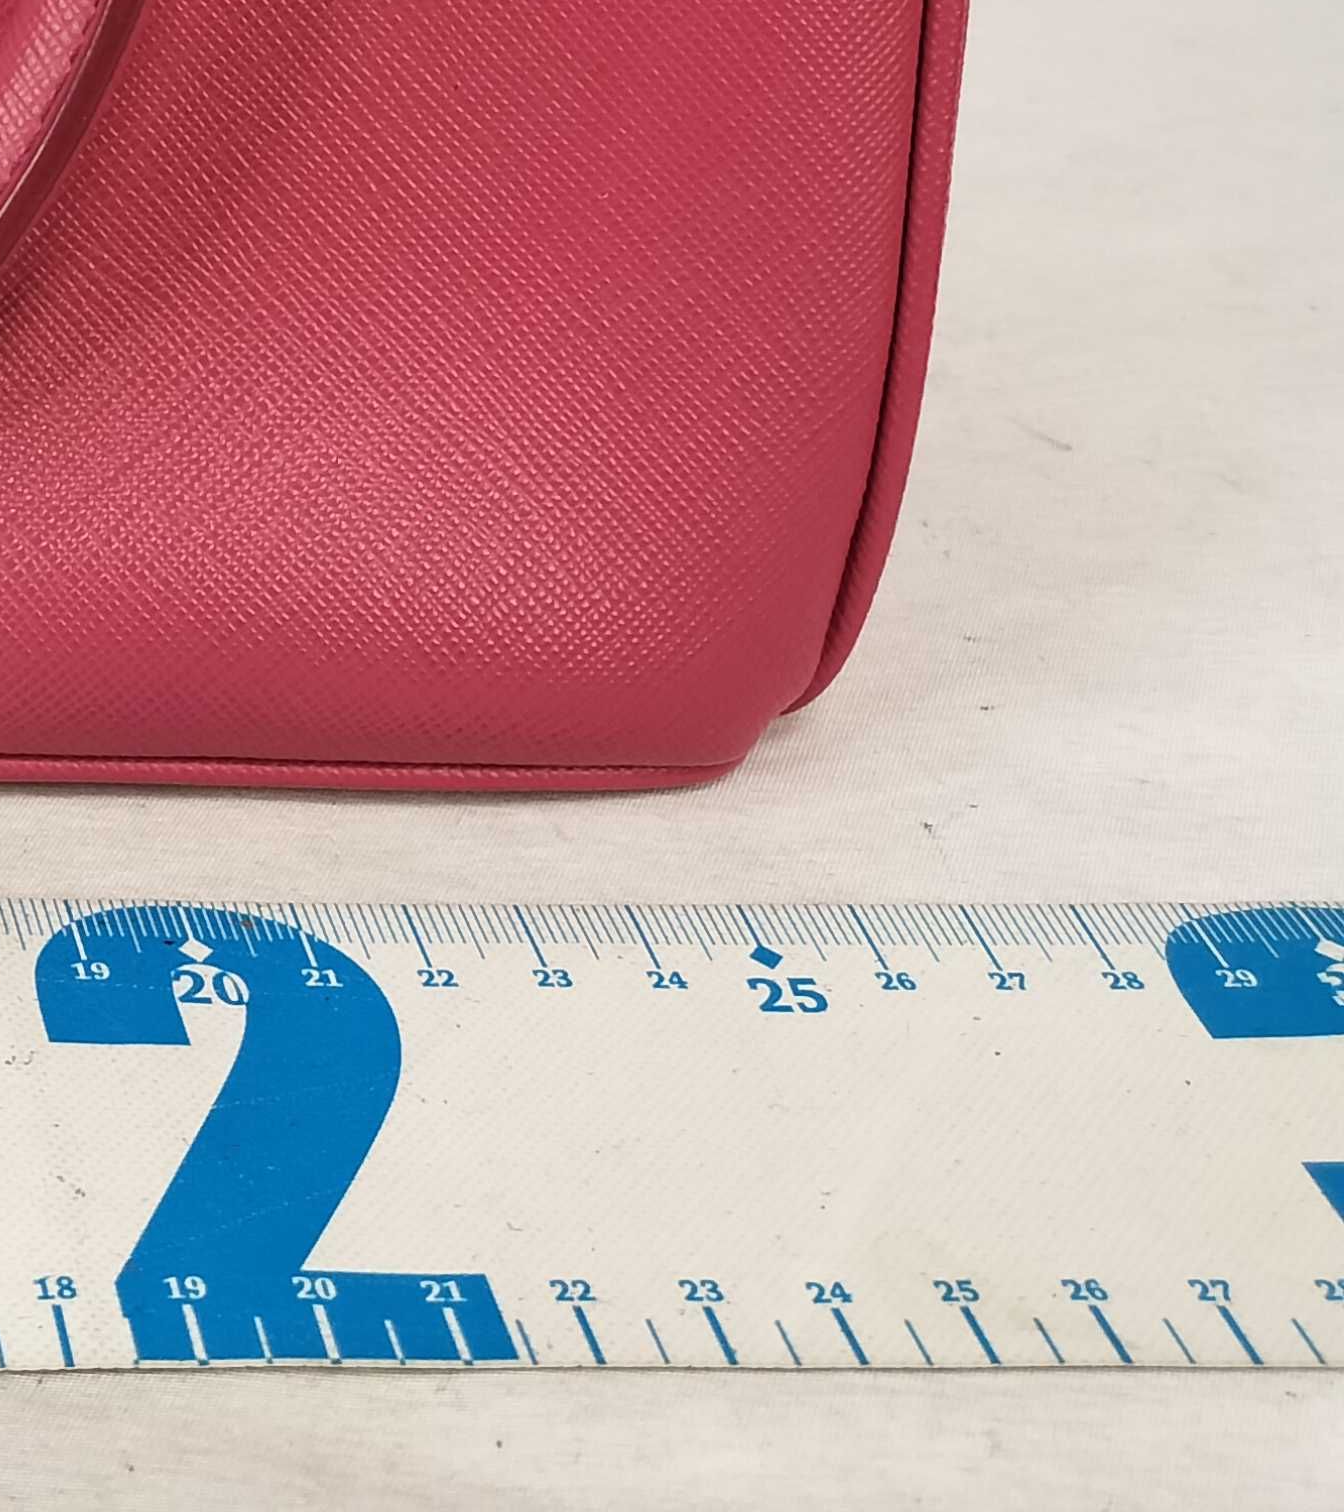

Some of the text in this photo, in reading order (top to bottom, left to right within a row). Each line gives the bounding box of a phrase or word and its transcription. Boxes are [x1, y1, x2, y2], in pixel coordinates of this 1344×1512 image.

[70, 960, 111, 981] 19
[172, 969, 248, 1006] 20
[301, 968, 343, 989] 21
[418, 969, 460, 990] 22
[533, 968, 574, 989] 23
[645, 970, 688, 991] 24
[748, 976, 829, 1014] 25
[874, 971, 917, 991] 26
[988, 971, 1028, 991] 27
[1102, 971, 1145, 991] 28
[1215, 968, 1259, 988] 29
[34, 904, 520, 1364] 2
[33, 1275, 78, 1301] 18
[162, 1276, 207, 1301] 19
[291, 1276, 337, 1301] 20
[420, 1279, 467, 1304] 21
[549, 1278, 597, 1302] 22
[678, 1279, 724, 1303] 23
[804, 1280, 852, 1303] 24
[933, 1279, 979, 1303] 25
[1060, 1279, 1108, 1302] 26
[1187, 1279, 1232, 1302] 27
